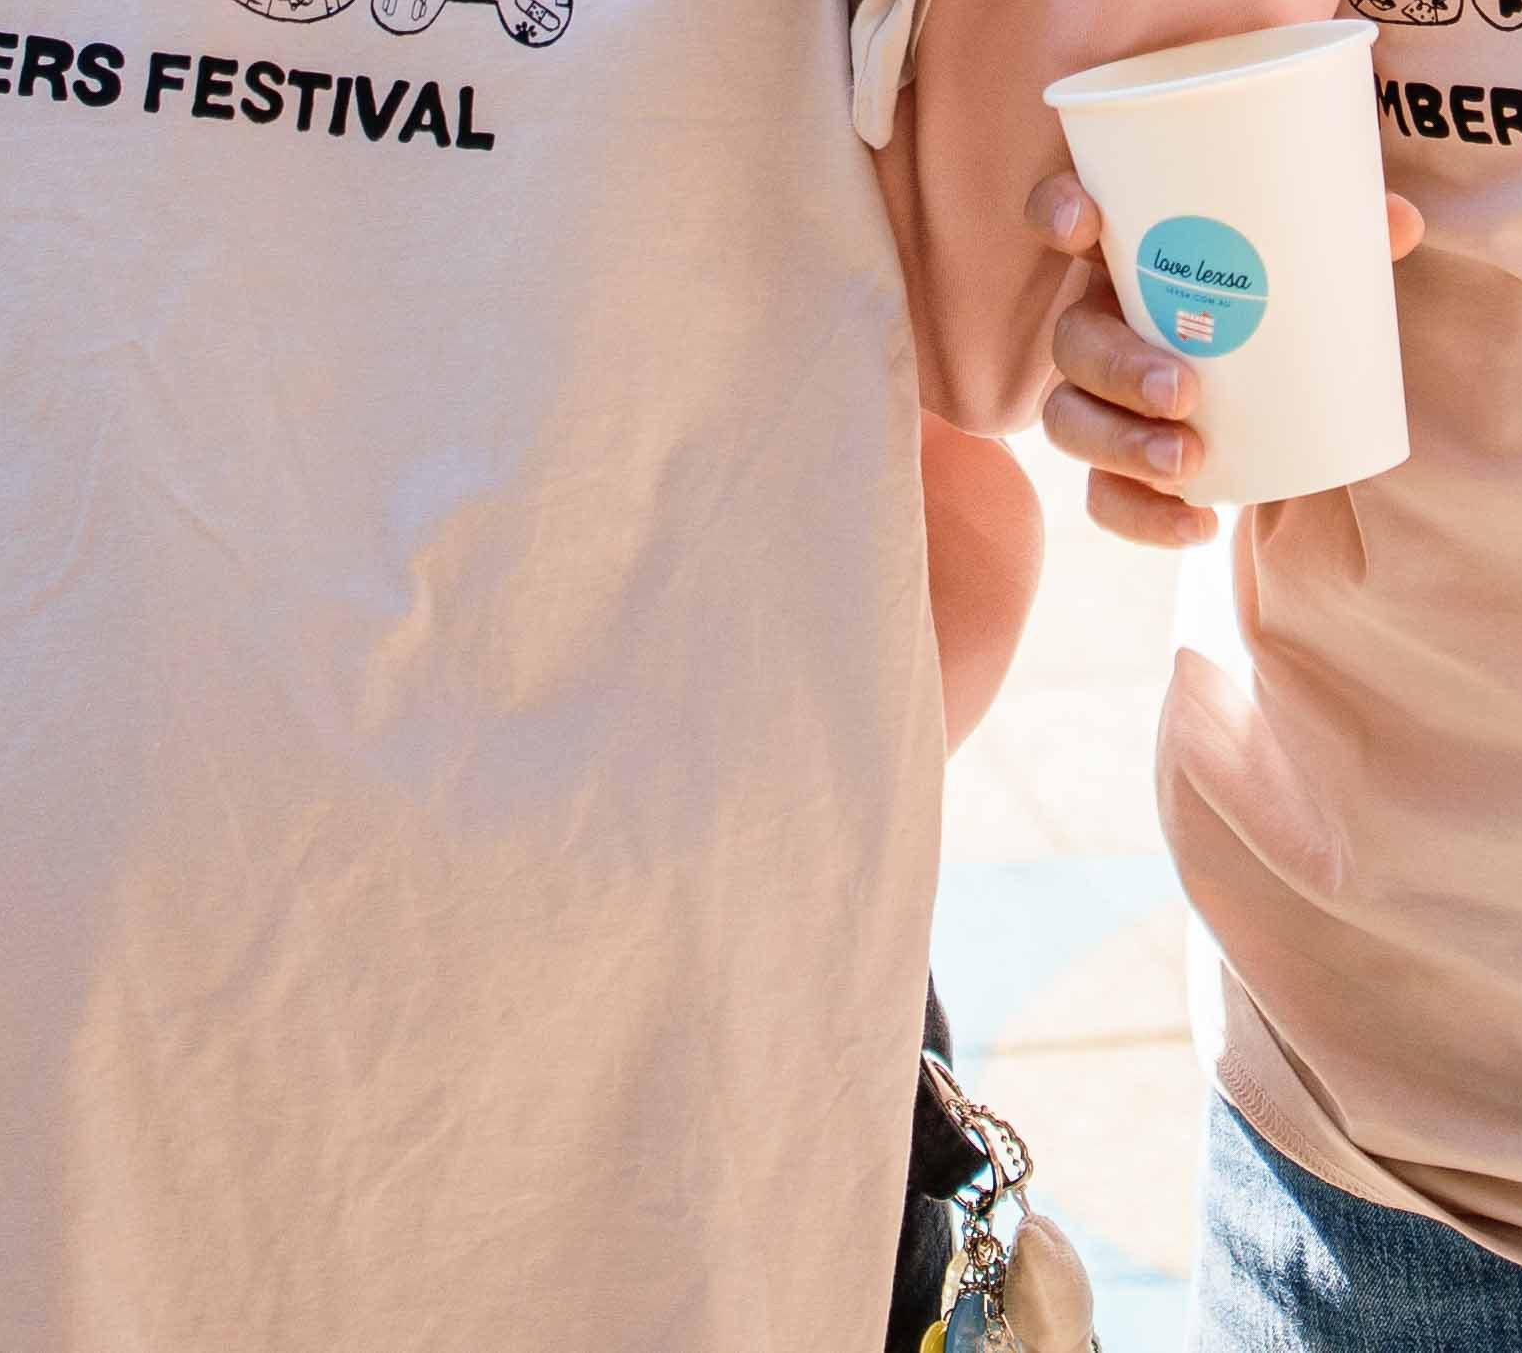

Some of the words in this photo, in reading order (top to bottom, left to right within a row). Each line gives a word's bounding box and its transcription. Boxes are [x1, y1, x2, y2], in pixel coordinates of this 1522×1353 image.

[143, 53, 495, 152] FESTIVAL
[1153, 248, 1193, 279] love
[1195, 259, 1253, 290] lexsa
